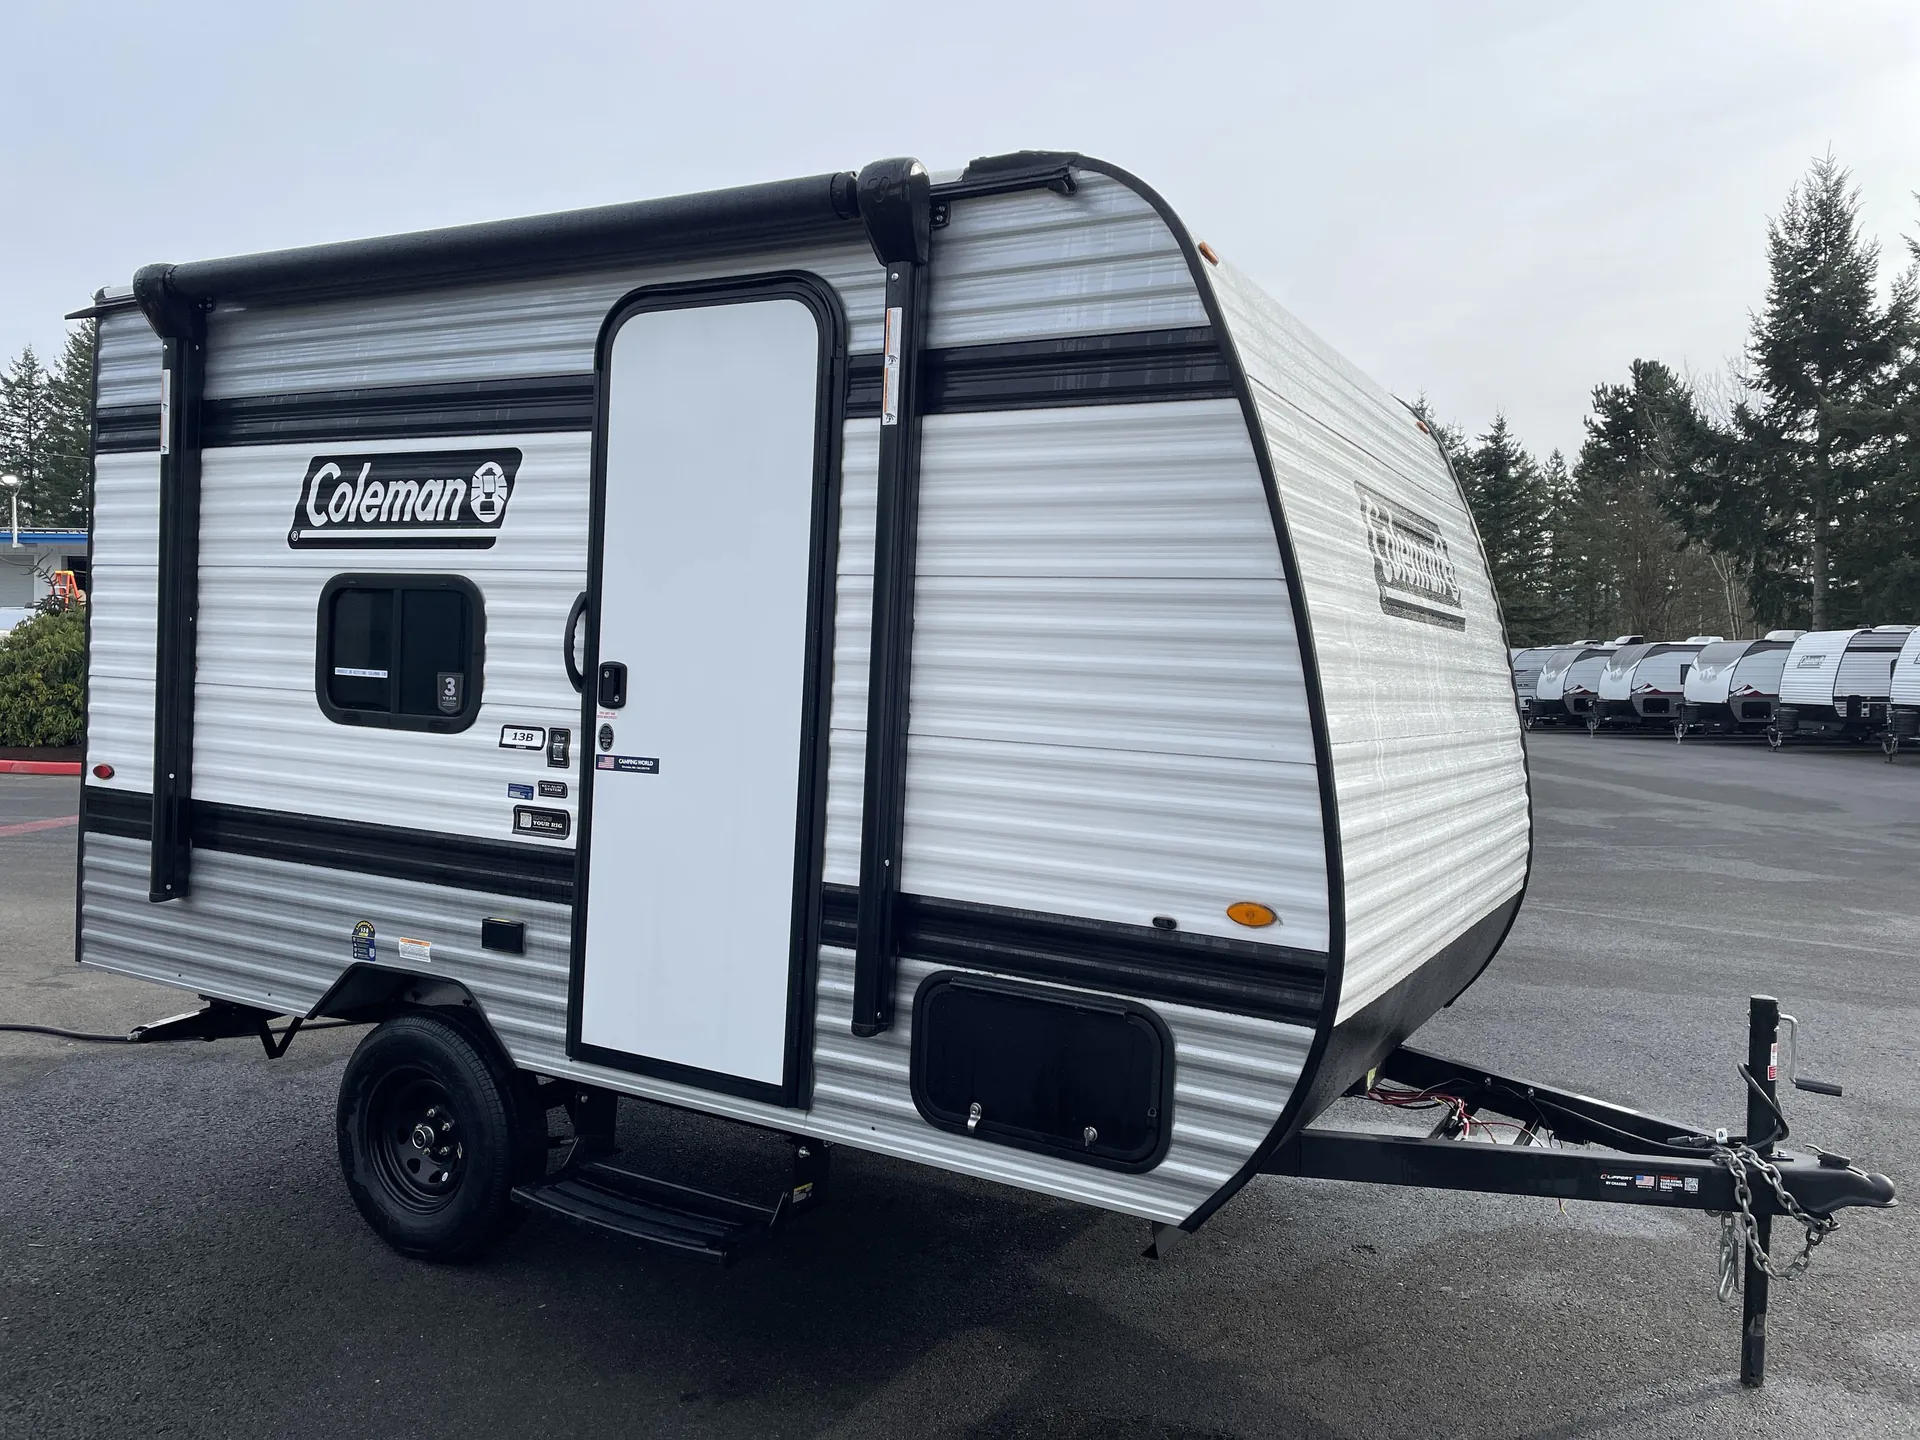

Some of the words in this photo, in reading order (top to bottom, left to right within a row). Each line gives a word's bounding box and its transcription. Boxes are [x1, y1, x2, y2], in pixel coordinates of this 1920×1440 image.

[306, 462, 467, 527] Coleman
[1364, 494, 1447, 596] Coleman
[444, 677, 456, 696] 3
[512, 732, 534, 742] 13B
[618, 758, 638, 766] CAMPING
